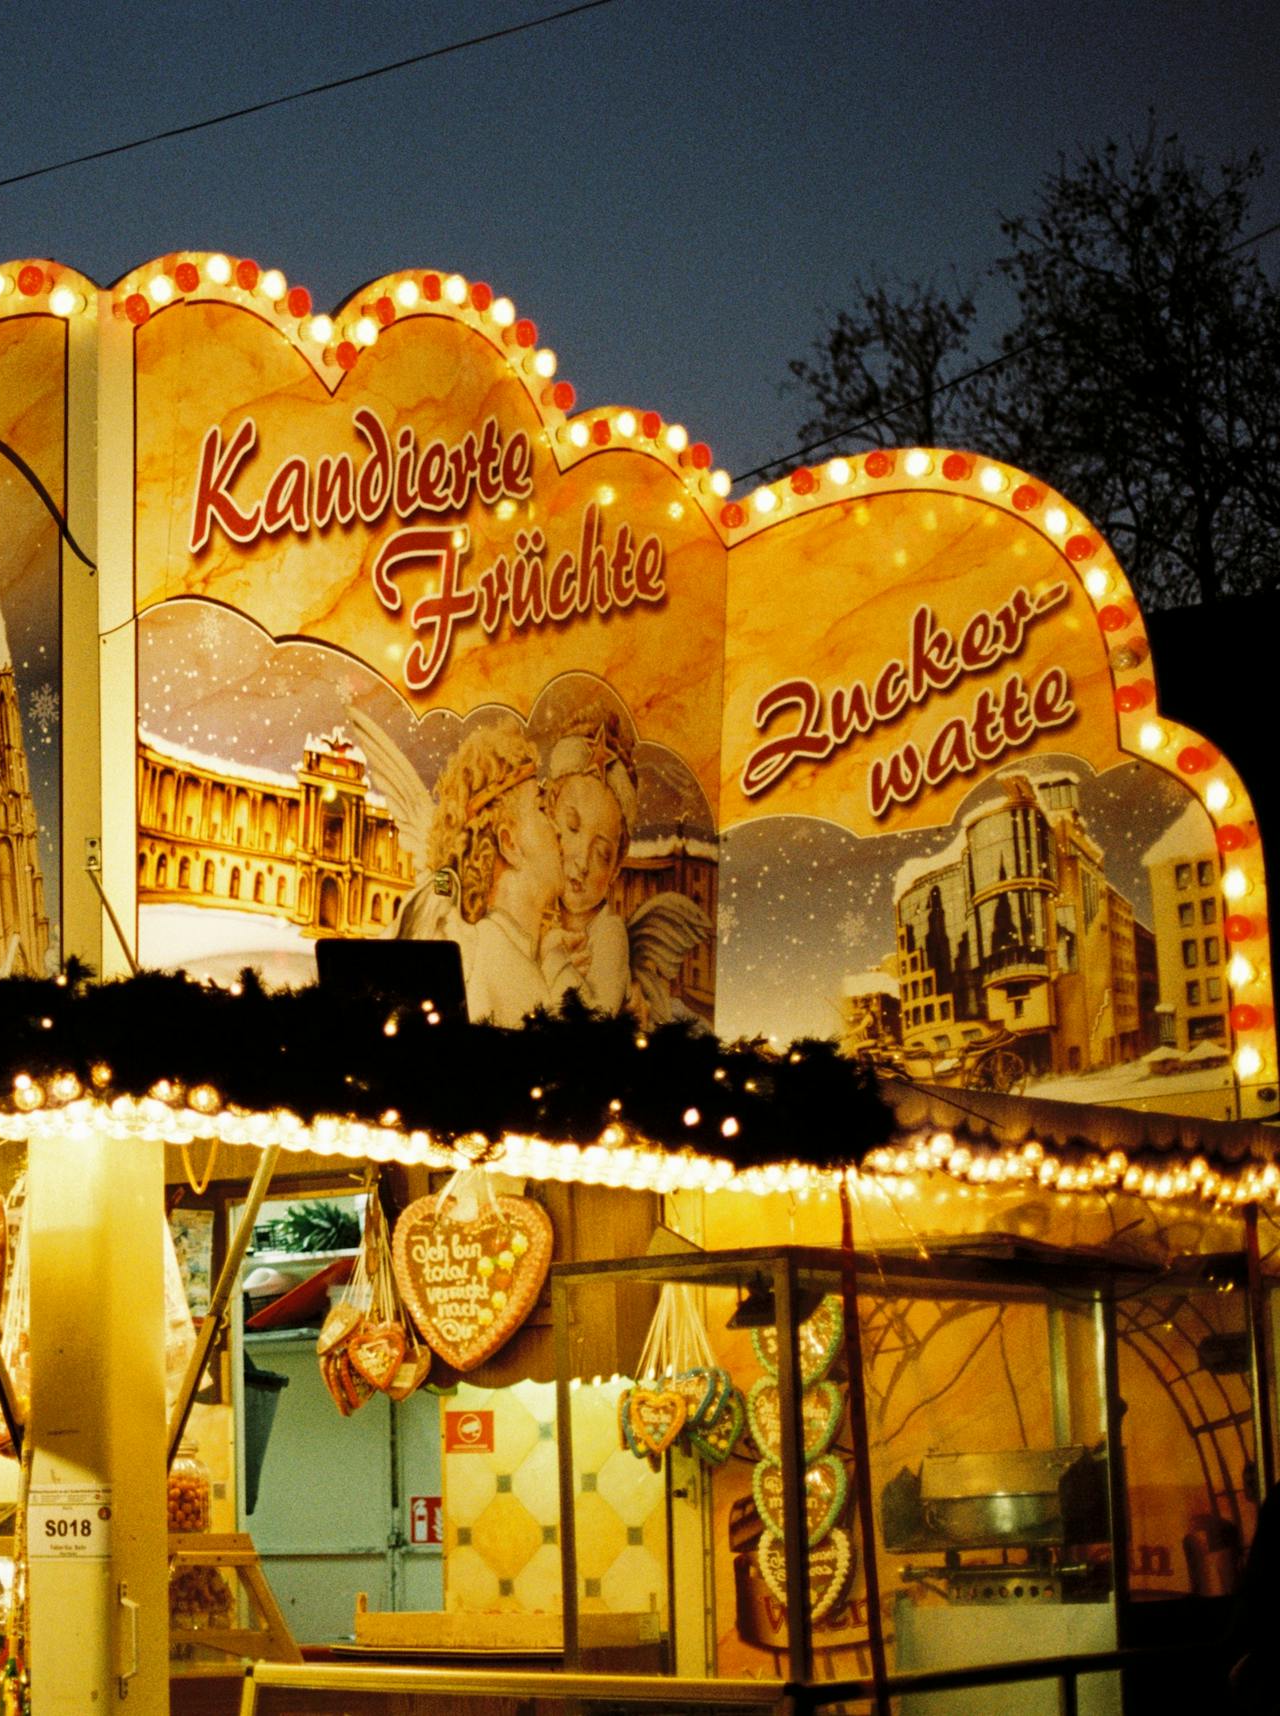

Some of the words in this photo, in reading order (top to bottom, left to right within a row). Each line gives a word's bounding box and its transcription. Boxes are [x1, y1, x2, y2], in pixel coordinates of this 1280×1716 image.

[189, 407, 533, 552] Kandierte
[373, 503, 667, 689] Früchte
[741, 581, 1068, 796] Zucker-
[868, 667, 1075, 816] watte
[411, 1235, 449, 1264] Ich
[451, 1234, 482, 1260] bin
[423, 1260, 469, 1283] total
[426, 1275, 490, 1304] verrückt
[437, 1299, 481, 1318] nach
[45, 1519, 92, 1537] S018
